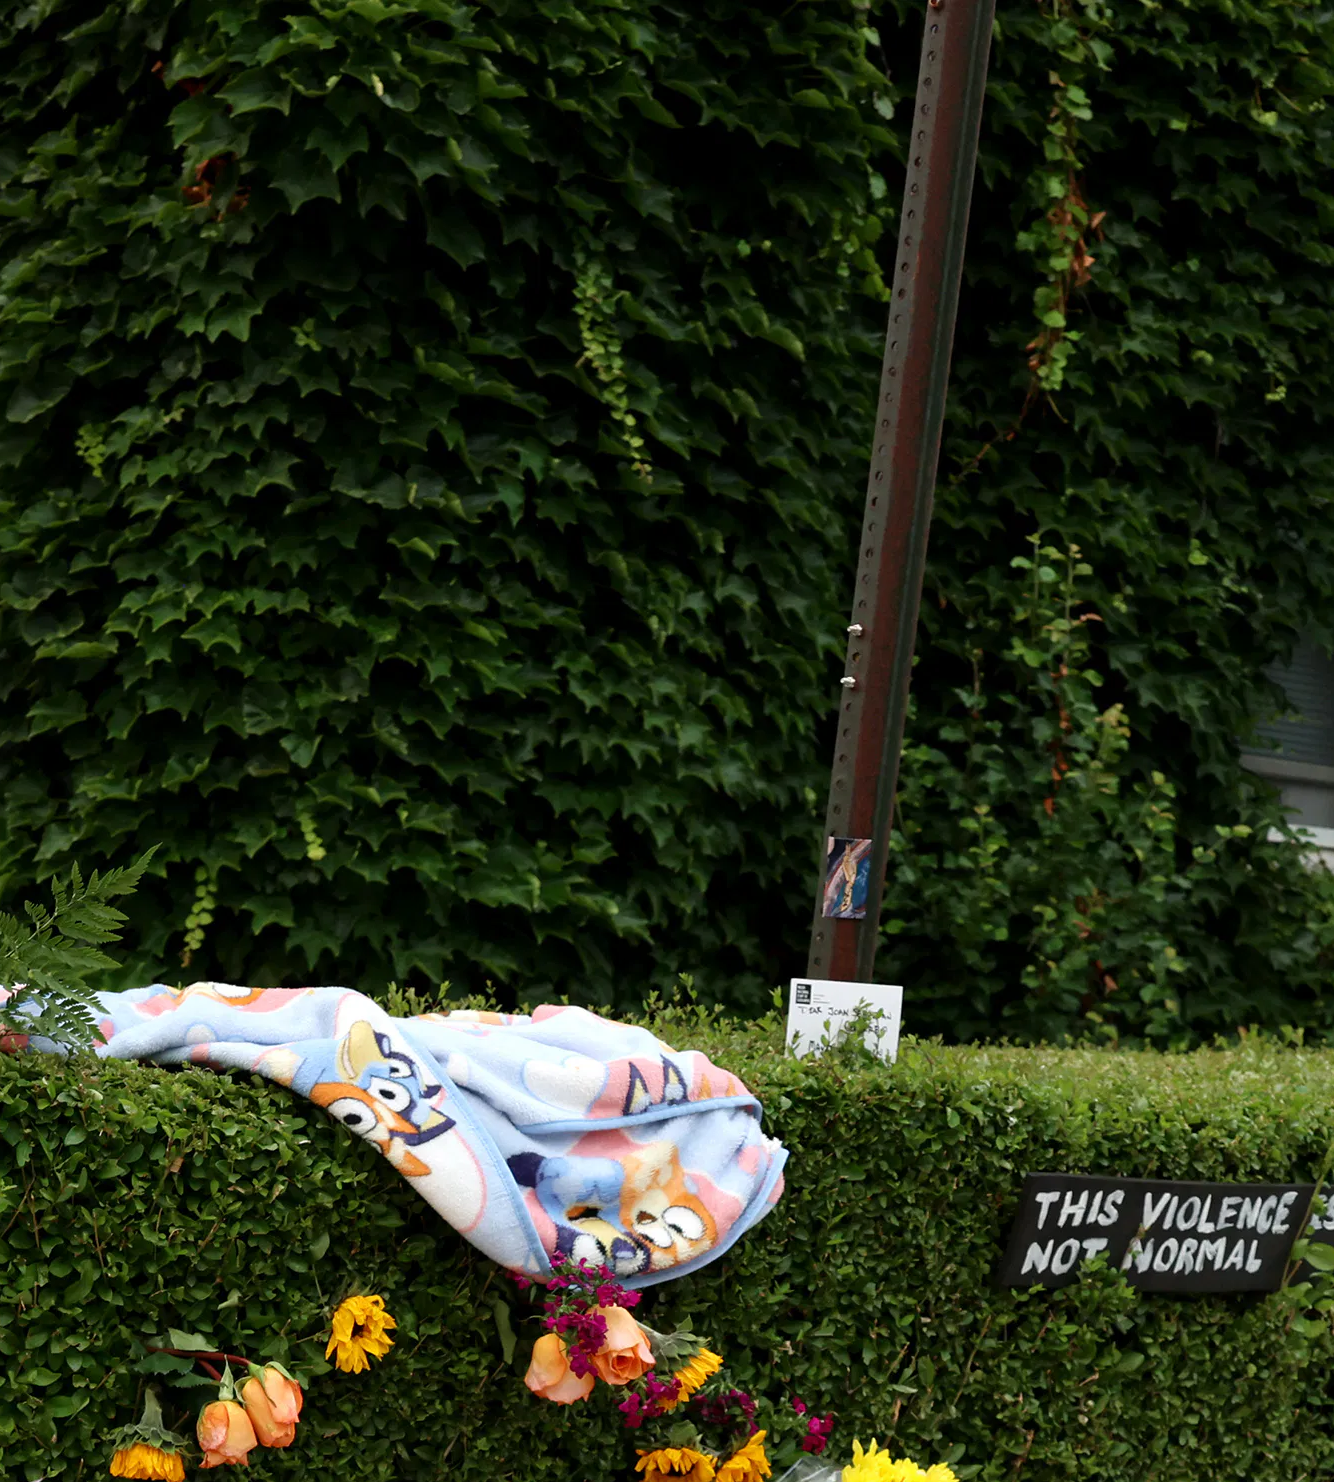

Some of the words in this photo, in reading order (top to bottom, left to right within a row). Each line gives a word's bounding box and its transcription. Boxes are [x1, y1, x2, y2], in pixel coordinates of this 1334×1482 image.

[1036, 1189, 1125, 1231] THIS
[1141, 1190, 1298, 1236] VIOLENCE
[1021, 1237, 1107, 1275] NOT
[1126, 1236, 1264, 1275] NORMAL
